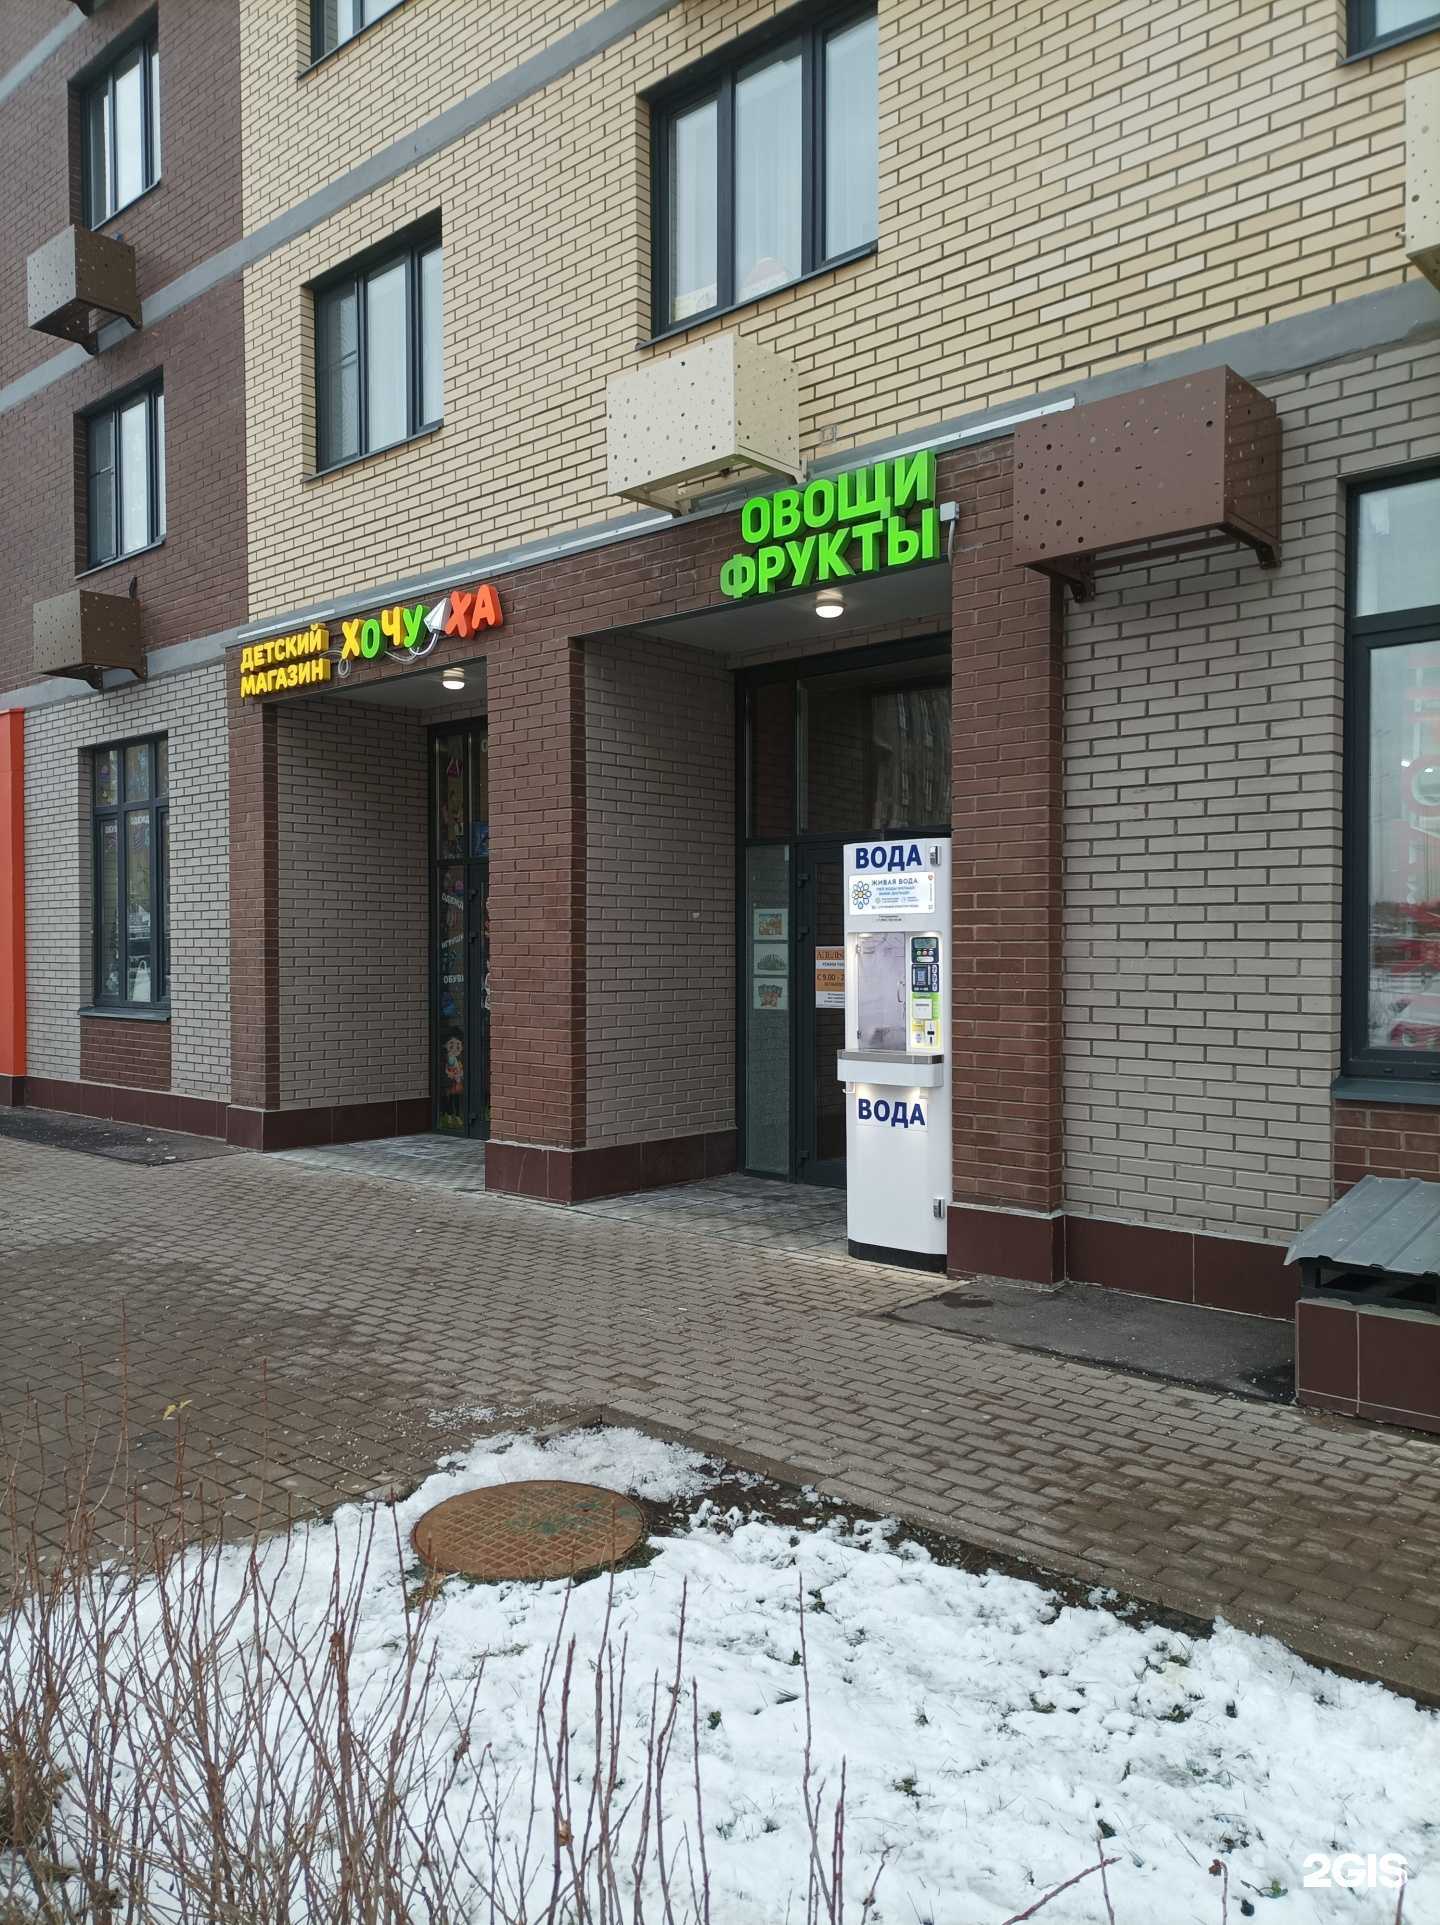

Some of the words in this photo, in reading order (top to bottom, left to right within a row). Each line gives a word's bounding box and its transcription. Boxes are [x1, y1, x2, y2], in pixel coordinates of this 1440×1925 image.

[741, 450, 937, 545] ОВОЩИ
[719, 507, 941, 599] ФРУКТЫ
[240, 622, 330, 674] ДЕТСКИЙ
[341, 604, 429, 662] ХОЧУ
[240, 657, 331, 699] МАГАЗИН
[855, 844, 922, 872] ВОДА
[898, 877, 918, 885] ВОДА
[858, 1098, 926, 1129] ВОДА
